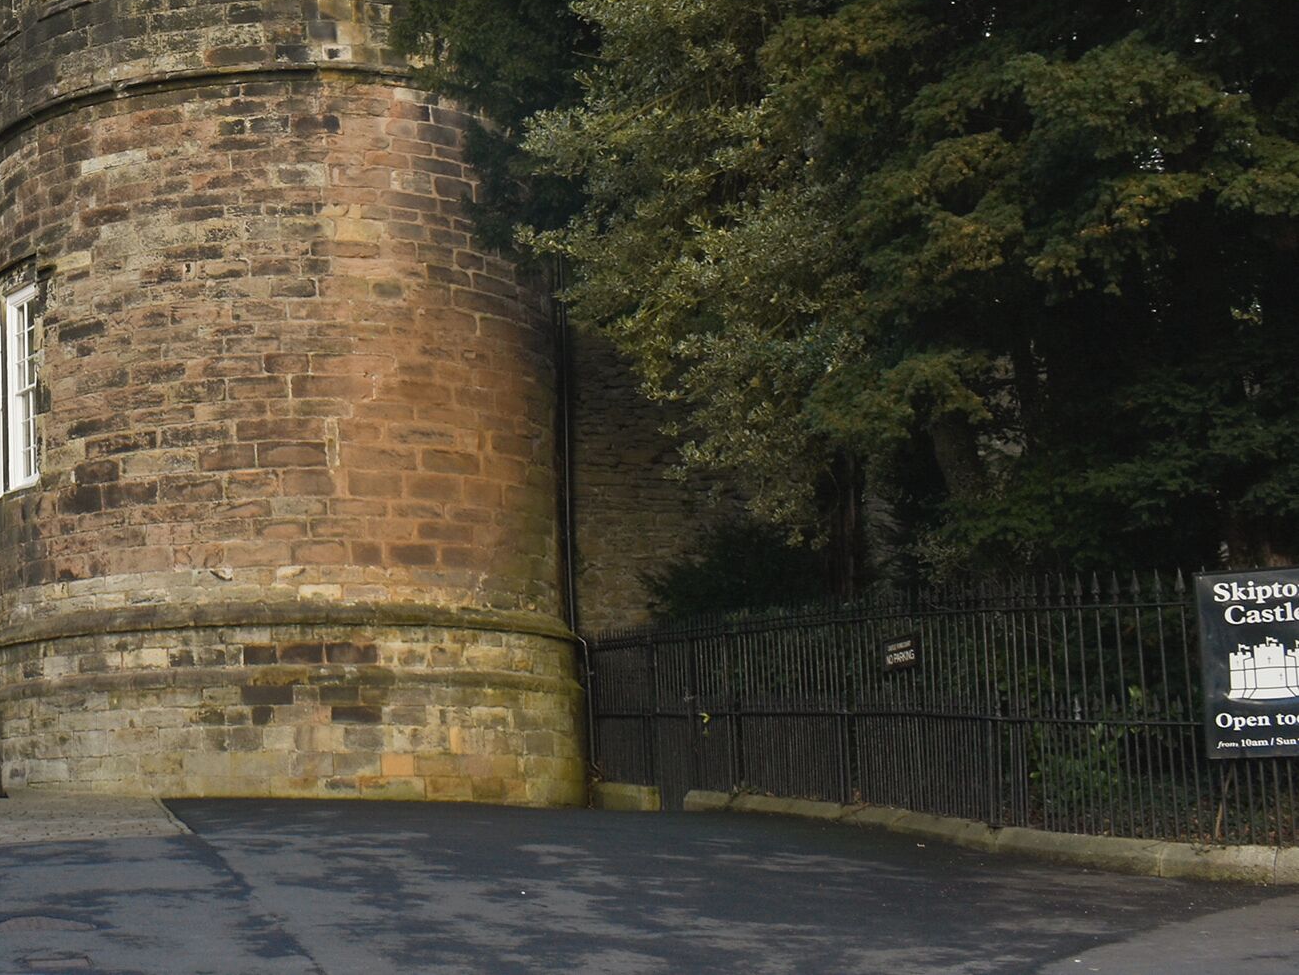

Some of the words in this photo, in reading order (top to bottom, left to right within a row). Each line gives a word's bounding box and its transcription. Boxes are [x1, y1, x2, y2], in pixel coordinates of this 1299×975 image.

[1213, 580, 1299, 604] Skipto
[1215, 712, 1271, 731] Open
[1275, 713, 1299, 726] to
[1216, 741, 1239, 749] from
[1241, 738, 1269, 747] 10am
[1276, 736, 1297, 746] Sun
